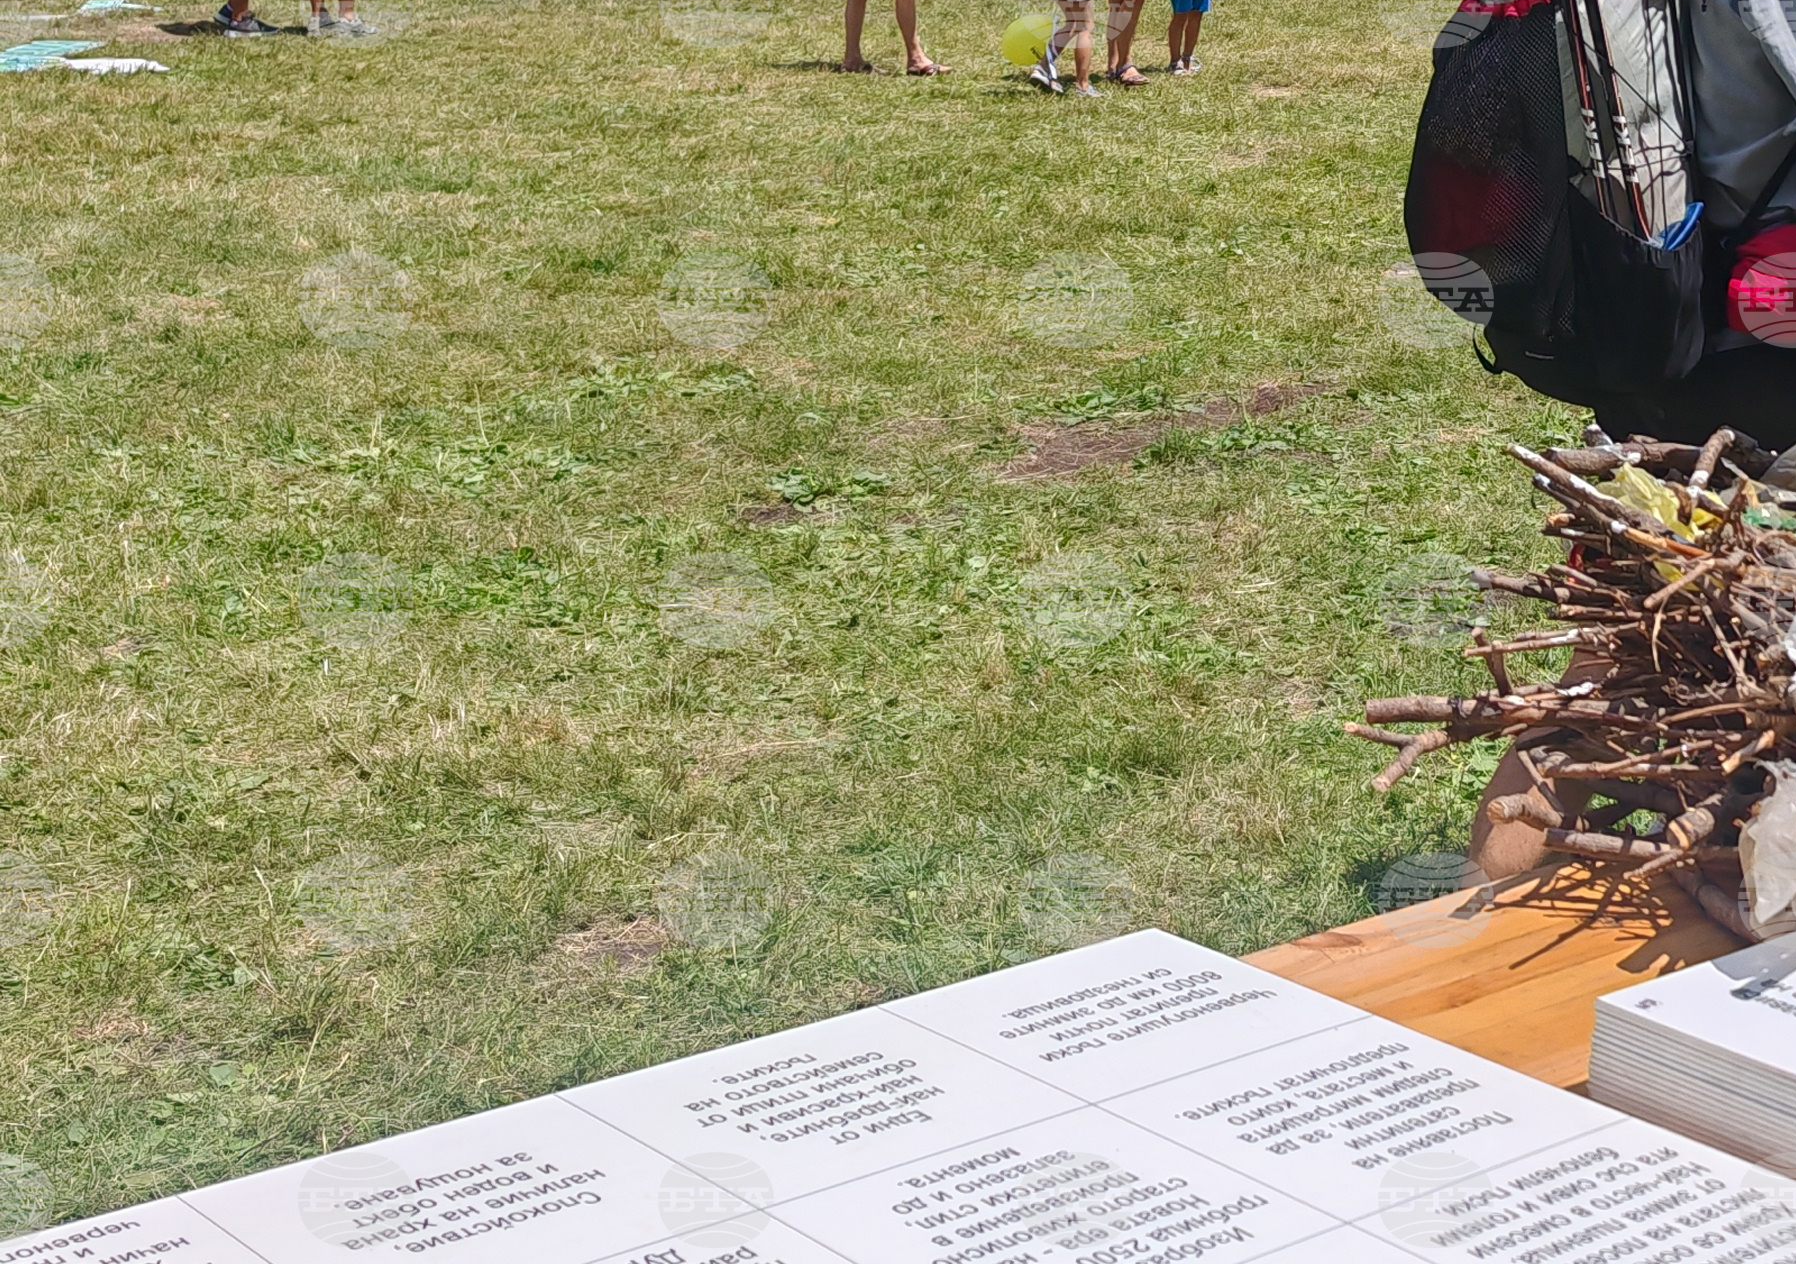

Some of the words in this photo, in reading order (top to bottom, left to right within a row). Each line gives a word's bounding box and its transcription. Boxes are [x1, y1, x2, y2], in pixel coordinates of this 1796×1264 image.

[1141, 968, 1171, 983] си
[1162, 971, 1221, 992] 8000
[1002, 977, 1140, 1019] гнездовища.
[1097, 996, 1125, 1010] до
[1120, 987, 1218, 1021] прелитат
[1127, 988, 1157, 1000] км
[999, 1007, 1095, 1039] зимните
[1049, 1017, 1117, 1041] почти
[1107, 990, 1277, 1041] Червеногушите
[1039, 1038, 1106, 1062] гъски
[712, 1054, 817, 1084] гъските.
[725, 1052, 884, 1101] семейството
[810, 1059, 916, 1093] обичани
[1273, 1043, 1409, 1091] предпочитат
[1390, 1060, 1414, 1075] и
[761, 1075, 923, 1126] най-красиви
[1295, 1067, 1391, 1106] местата,
[1371, 1068, 1453, 1103] следим
[684, 1098, 721, 1112] на
[731, 1090, 809, 1117] птици
[760, 1086, 945, 1142] най-дребните,
[1175, 1087, 1272, 1120] гъските.
[1227, 1099, 1294, 1126] които
[1237, 1094, 1369, 1143] миграцията
[1332, 1079, 1480, 1138] предаватели,
[697, 1114, 727, 1128] от
[737, 1123, 759, 1133] и
[863, 1110, 932, 1133] Едни
[1344, 1106, 1460, 1150] сателитни
[829, 1131, 860, 1145] от
[1266, 1138, 1296, 1155] да
[1297, 1129, 1329, 1149] за
[1387, 1111, 1513, 1162] Поставяне
[496, 1152, 532, 1166] за
[536, 1164, 559, 1174] и
[898, 1147, 1020, 1188] момента.
[955, 1151, 1075, 1194] запазено
[1352, 1154, 1385, 1169] на
[334, 1163, 489, 1210] нощуване.
[443, 1171, 532, 1201] воден
[485, 1169, 606, 1209] наличие
[930, 1191, 952, 1202] и
[982, 1161, 1110, 1207] египетски
[1087, 1178, 1188, 1216] старото
[353, 1199, 437, 1229] обект
[439, 1206, 480, 1221] на
[892, 1196, 928, 1214] до
[905, 1204, 978, 1229] стил,
[955, 1172, 1139, 1238] произведение
[1109, 1194, 1210, 1231] Новата
[341, 1218, 437, 1250] храна
[394, 1191, 601, 1252] Спокойствие,
[1147, 1195, 1268, 1252] гробница
[73, 1247, 95, 1258] и
[931, 1235, 952, 1246] в
[1057, 1229, 1108, 1250] ера
